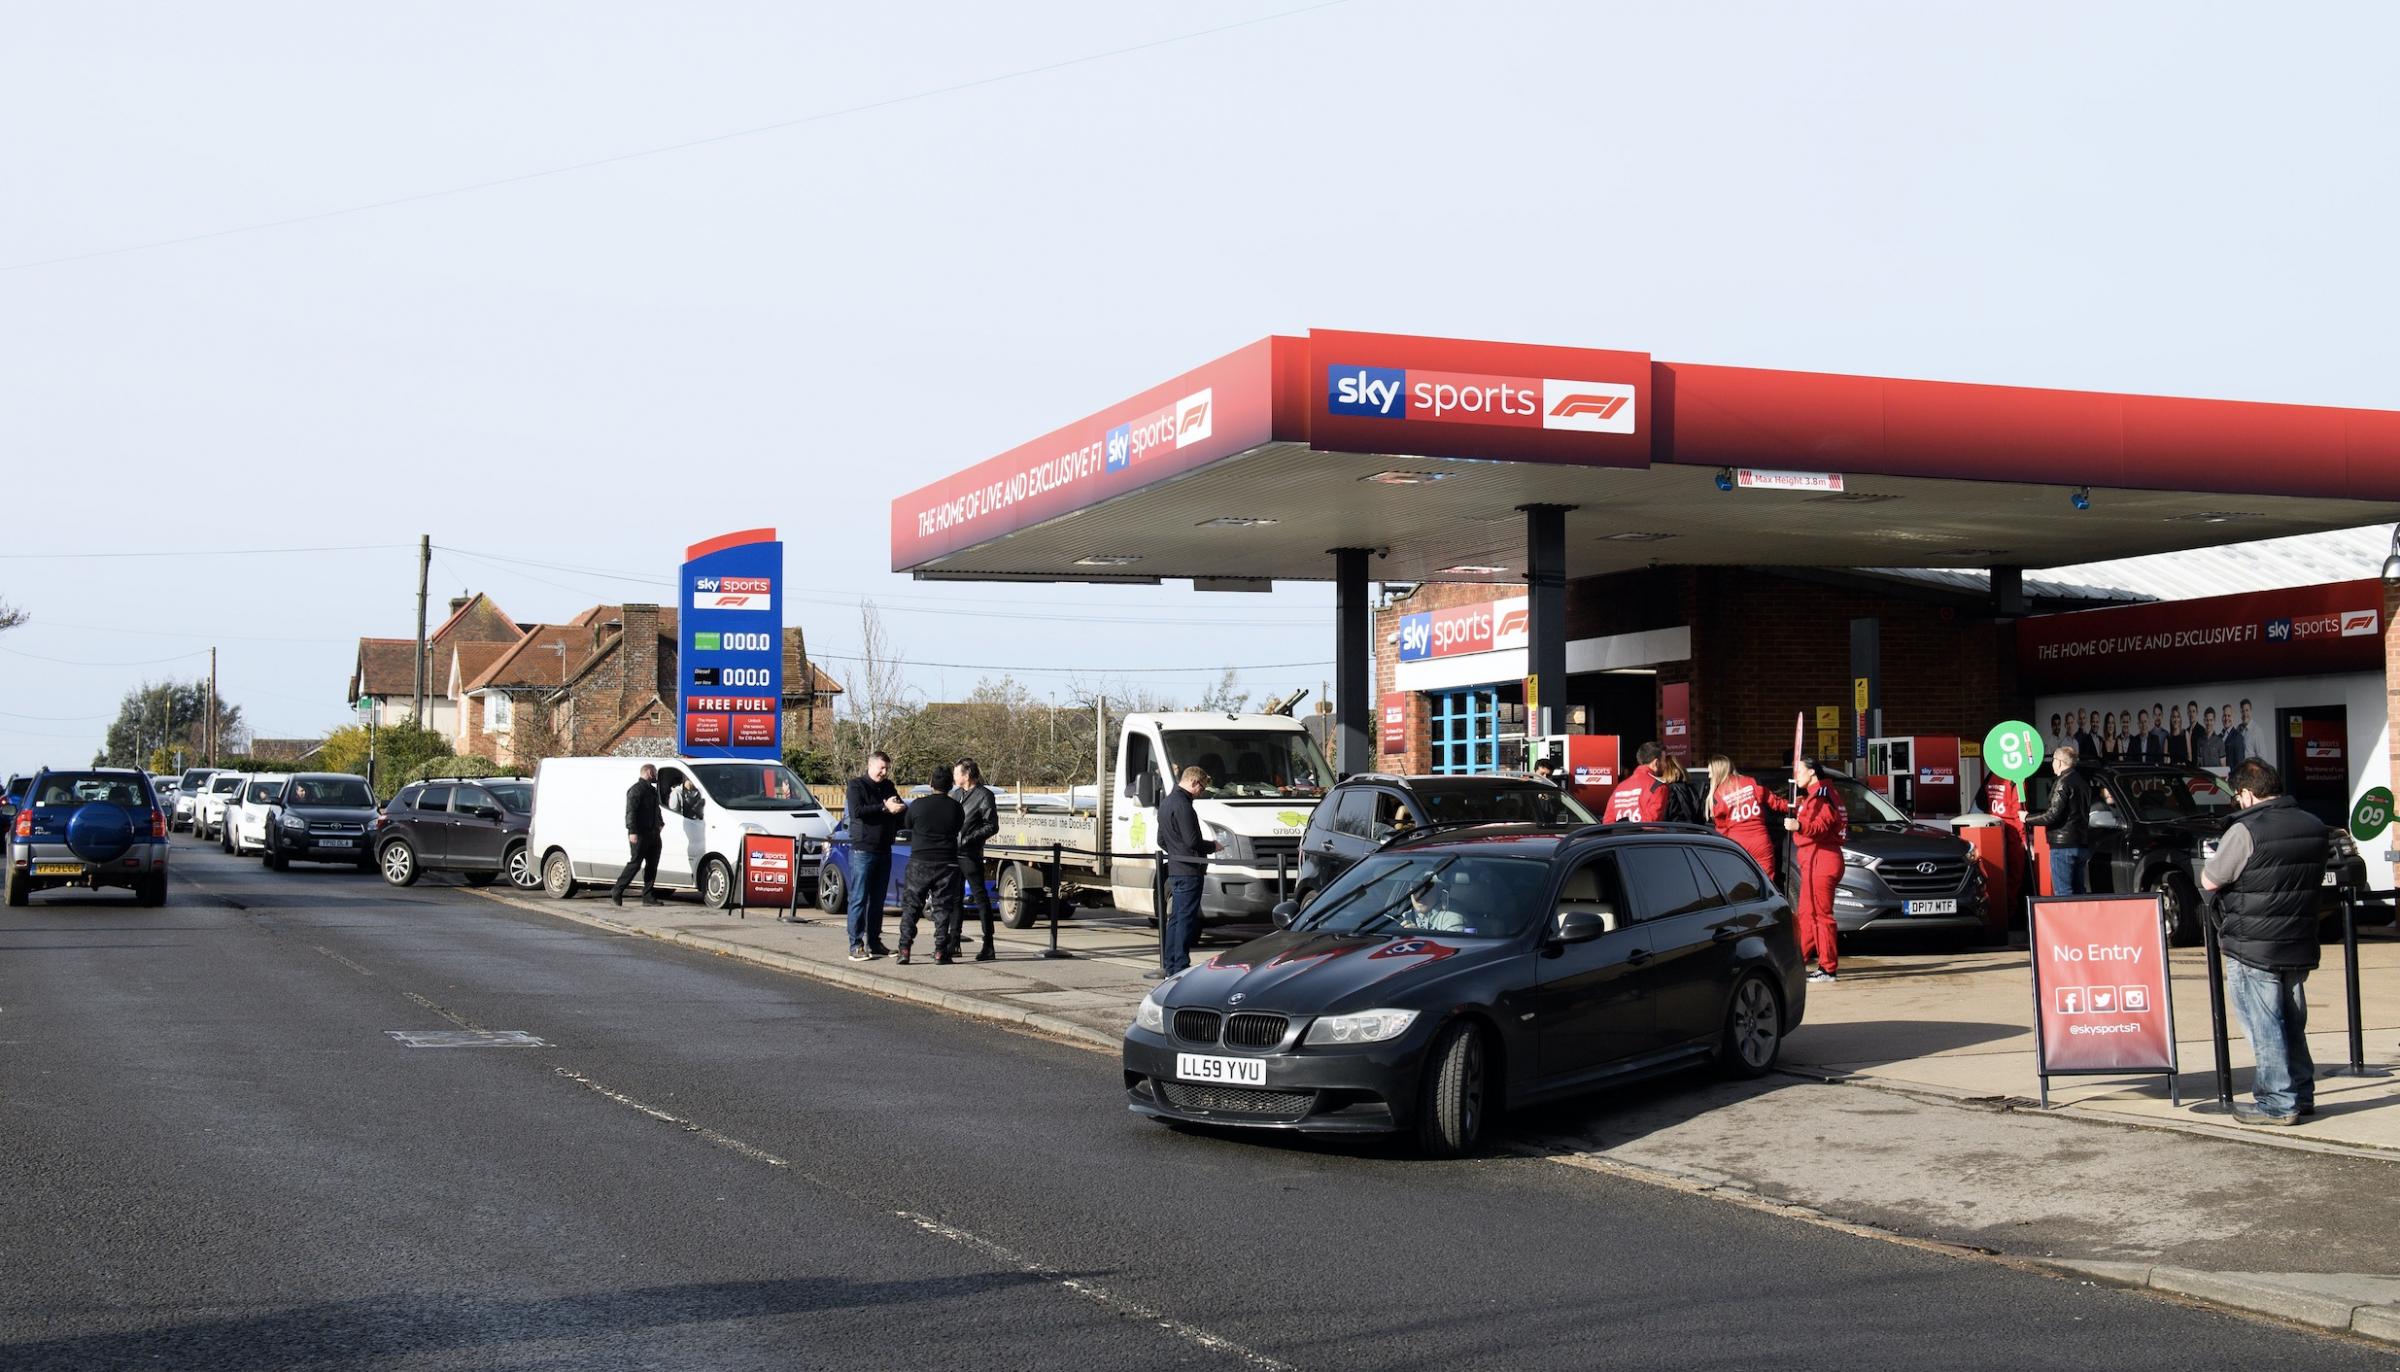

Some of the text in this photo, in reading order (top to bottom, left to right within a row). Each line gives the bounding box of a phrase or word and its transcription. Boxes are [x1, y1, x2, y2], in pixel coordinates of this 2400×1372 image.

[1338, 370, 1400, 414] sky
[1414, 382, 1536, 417] sports
[1108, 431, 1129, 466] sky
[1132, 415, 1175, 459] sports
[918, 440, 1103, 538] THE HOME OF LIVE AND EXCLUSIVE F1
[1755, 475, 1827, 486] Max Height 3.8m
[697, 577, 768, 592] sky sports
[1403, 618, 1430, 656] sky
[1435, 611, 1491, 652] sports
[2267, 621, 2290, 640] sky
[2294, 617, 2340, 638] sports
[723, 632, 770, 651] 000.0
[2038, 624, 2258, 660] THE HOME OF LIVE AND EXCLUSIVE F1
[723, 668, 770, 687] 000.0
[698, 698, 768, 711] FREE FUEL
[2000, 732, 2023, 770] GO
[1576, 767, 1611, 776] sky sports
[1921, 767, 1953, 776] sky sports
[1730, 800, 1761, 822] 406
[1912, 900, 1953, 913] DP17 MTF
[2053, 944, 2143, 964] No Entry
[2069, 1022, 2141, 1036] @skysportsF1
[1183, 1057, 1260, 1081] LL59 YVU
